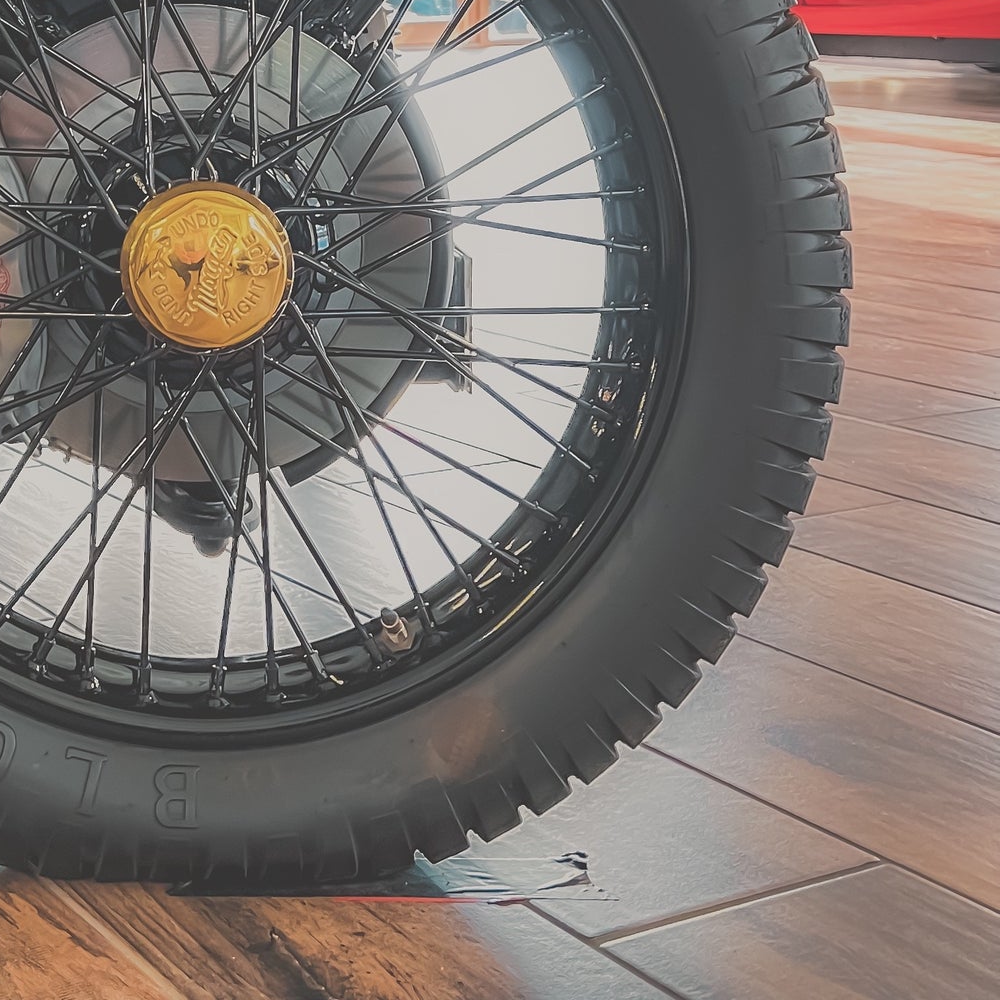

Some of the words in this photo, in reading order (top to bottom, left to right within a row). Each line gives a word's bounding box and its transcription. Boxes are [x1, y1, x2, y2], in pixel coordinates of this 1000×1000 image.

[169, 209, 220, 237] UNDO
[151, 283, 194, 327] UNDO
[221, 277, 266, 329] RIGHT
